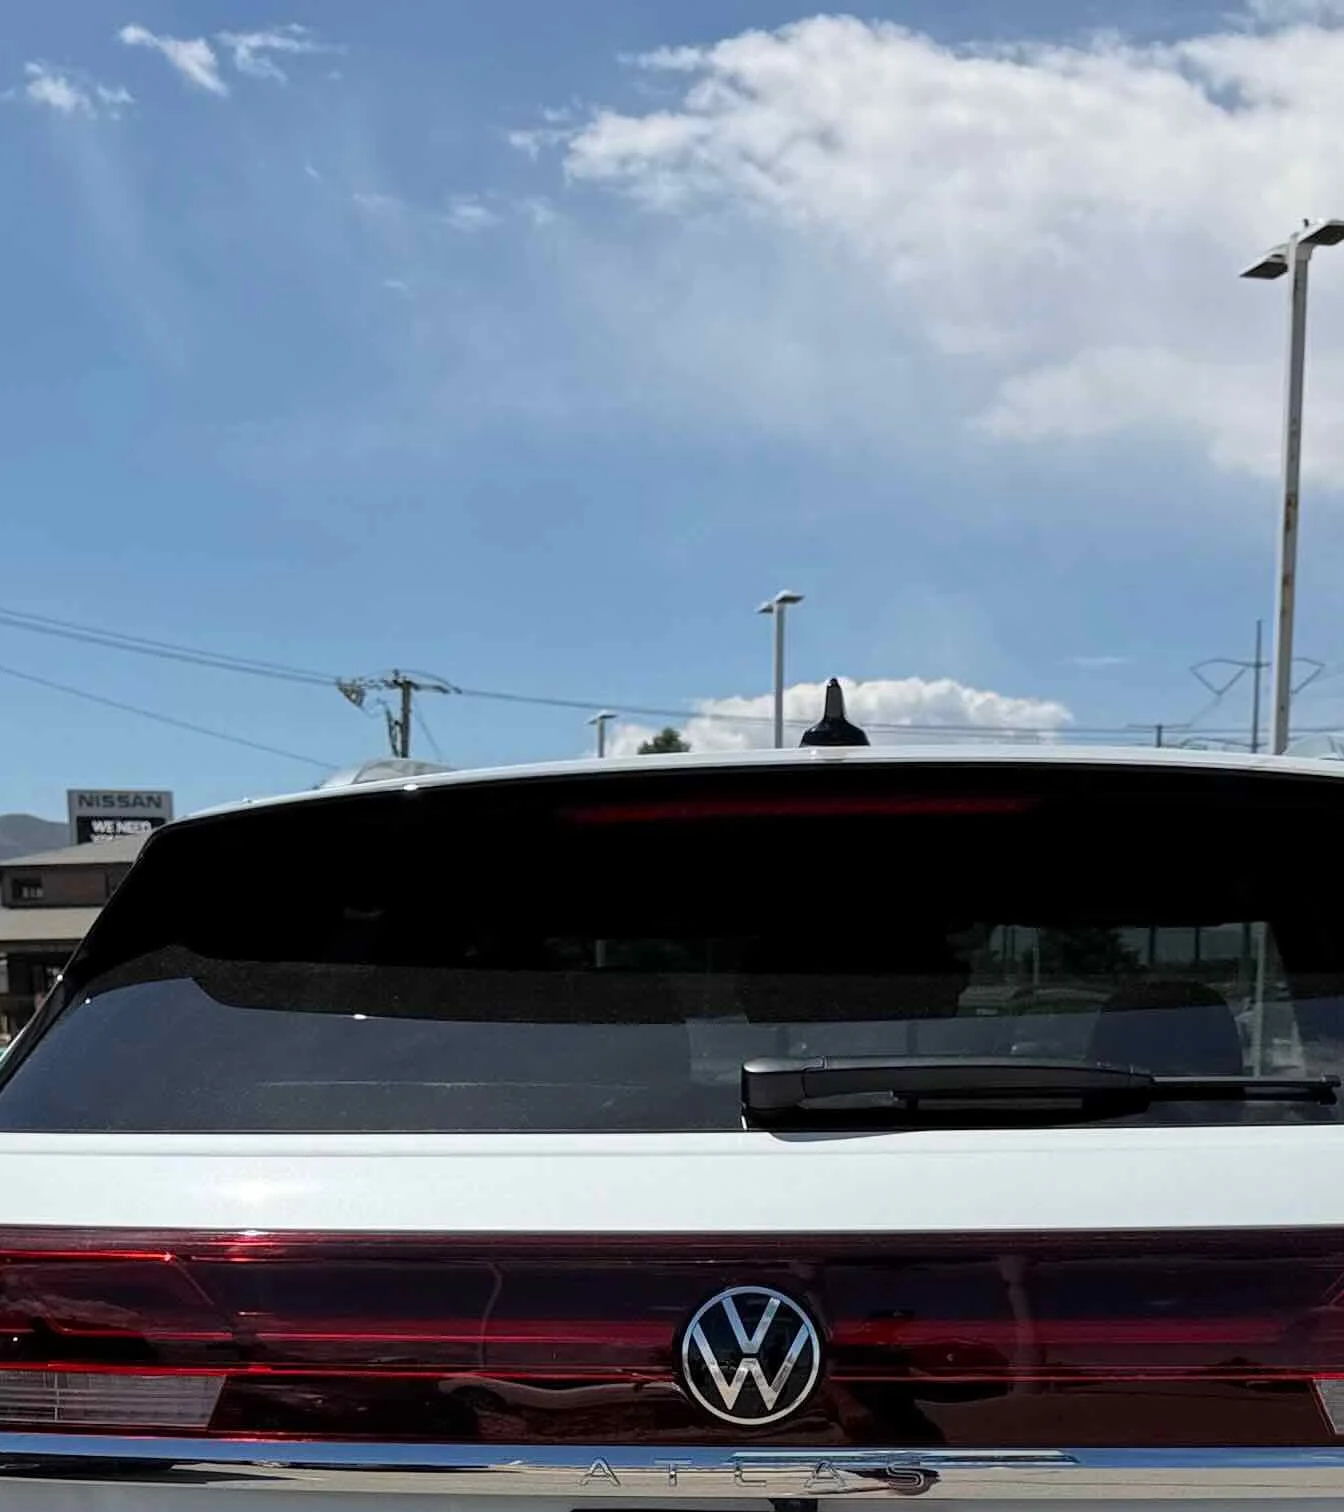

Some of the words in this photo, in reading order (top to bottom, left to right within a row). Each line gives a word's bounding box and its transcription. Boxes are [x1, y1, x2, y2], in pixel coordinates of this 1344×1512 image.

[77, 794, 162, 808] NISSAN
[91, 820, 114, 833] WE
[682, 1286, 820, 1425] VW
[578, 1456, 926, 1489] ATLAS
